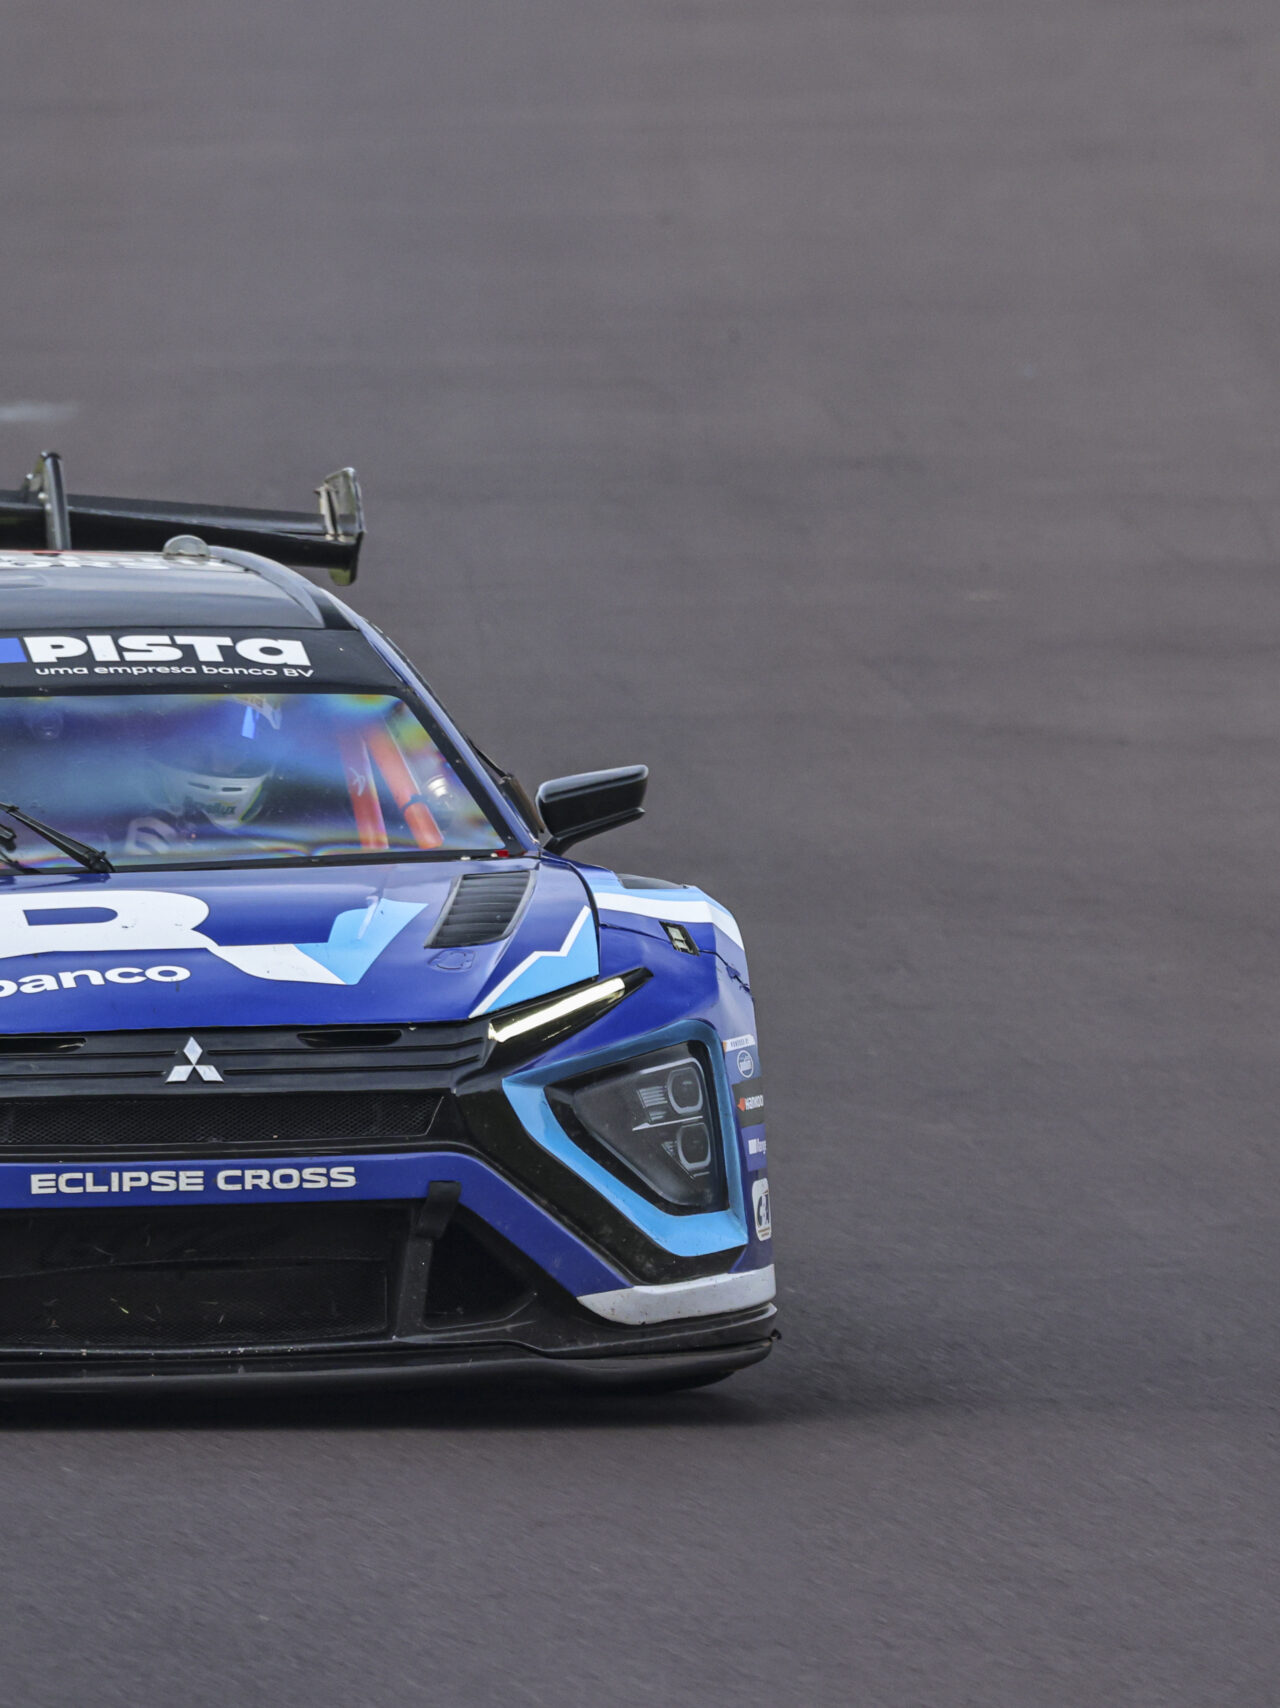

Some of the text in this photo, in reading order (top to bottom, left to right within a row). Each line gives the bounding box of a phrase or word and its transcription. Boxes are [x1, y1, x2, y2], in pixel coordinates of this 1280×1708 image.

[35, 665, 314, 677] uma empresa banco BV
[30, 1166, 357, 1195] ECLIPSE CROSS
